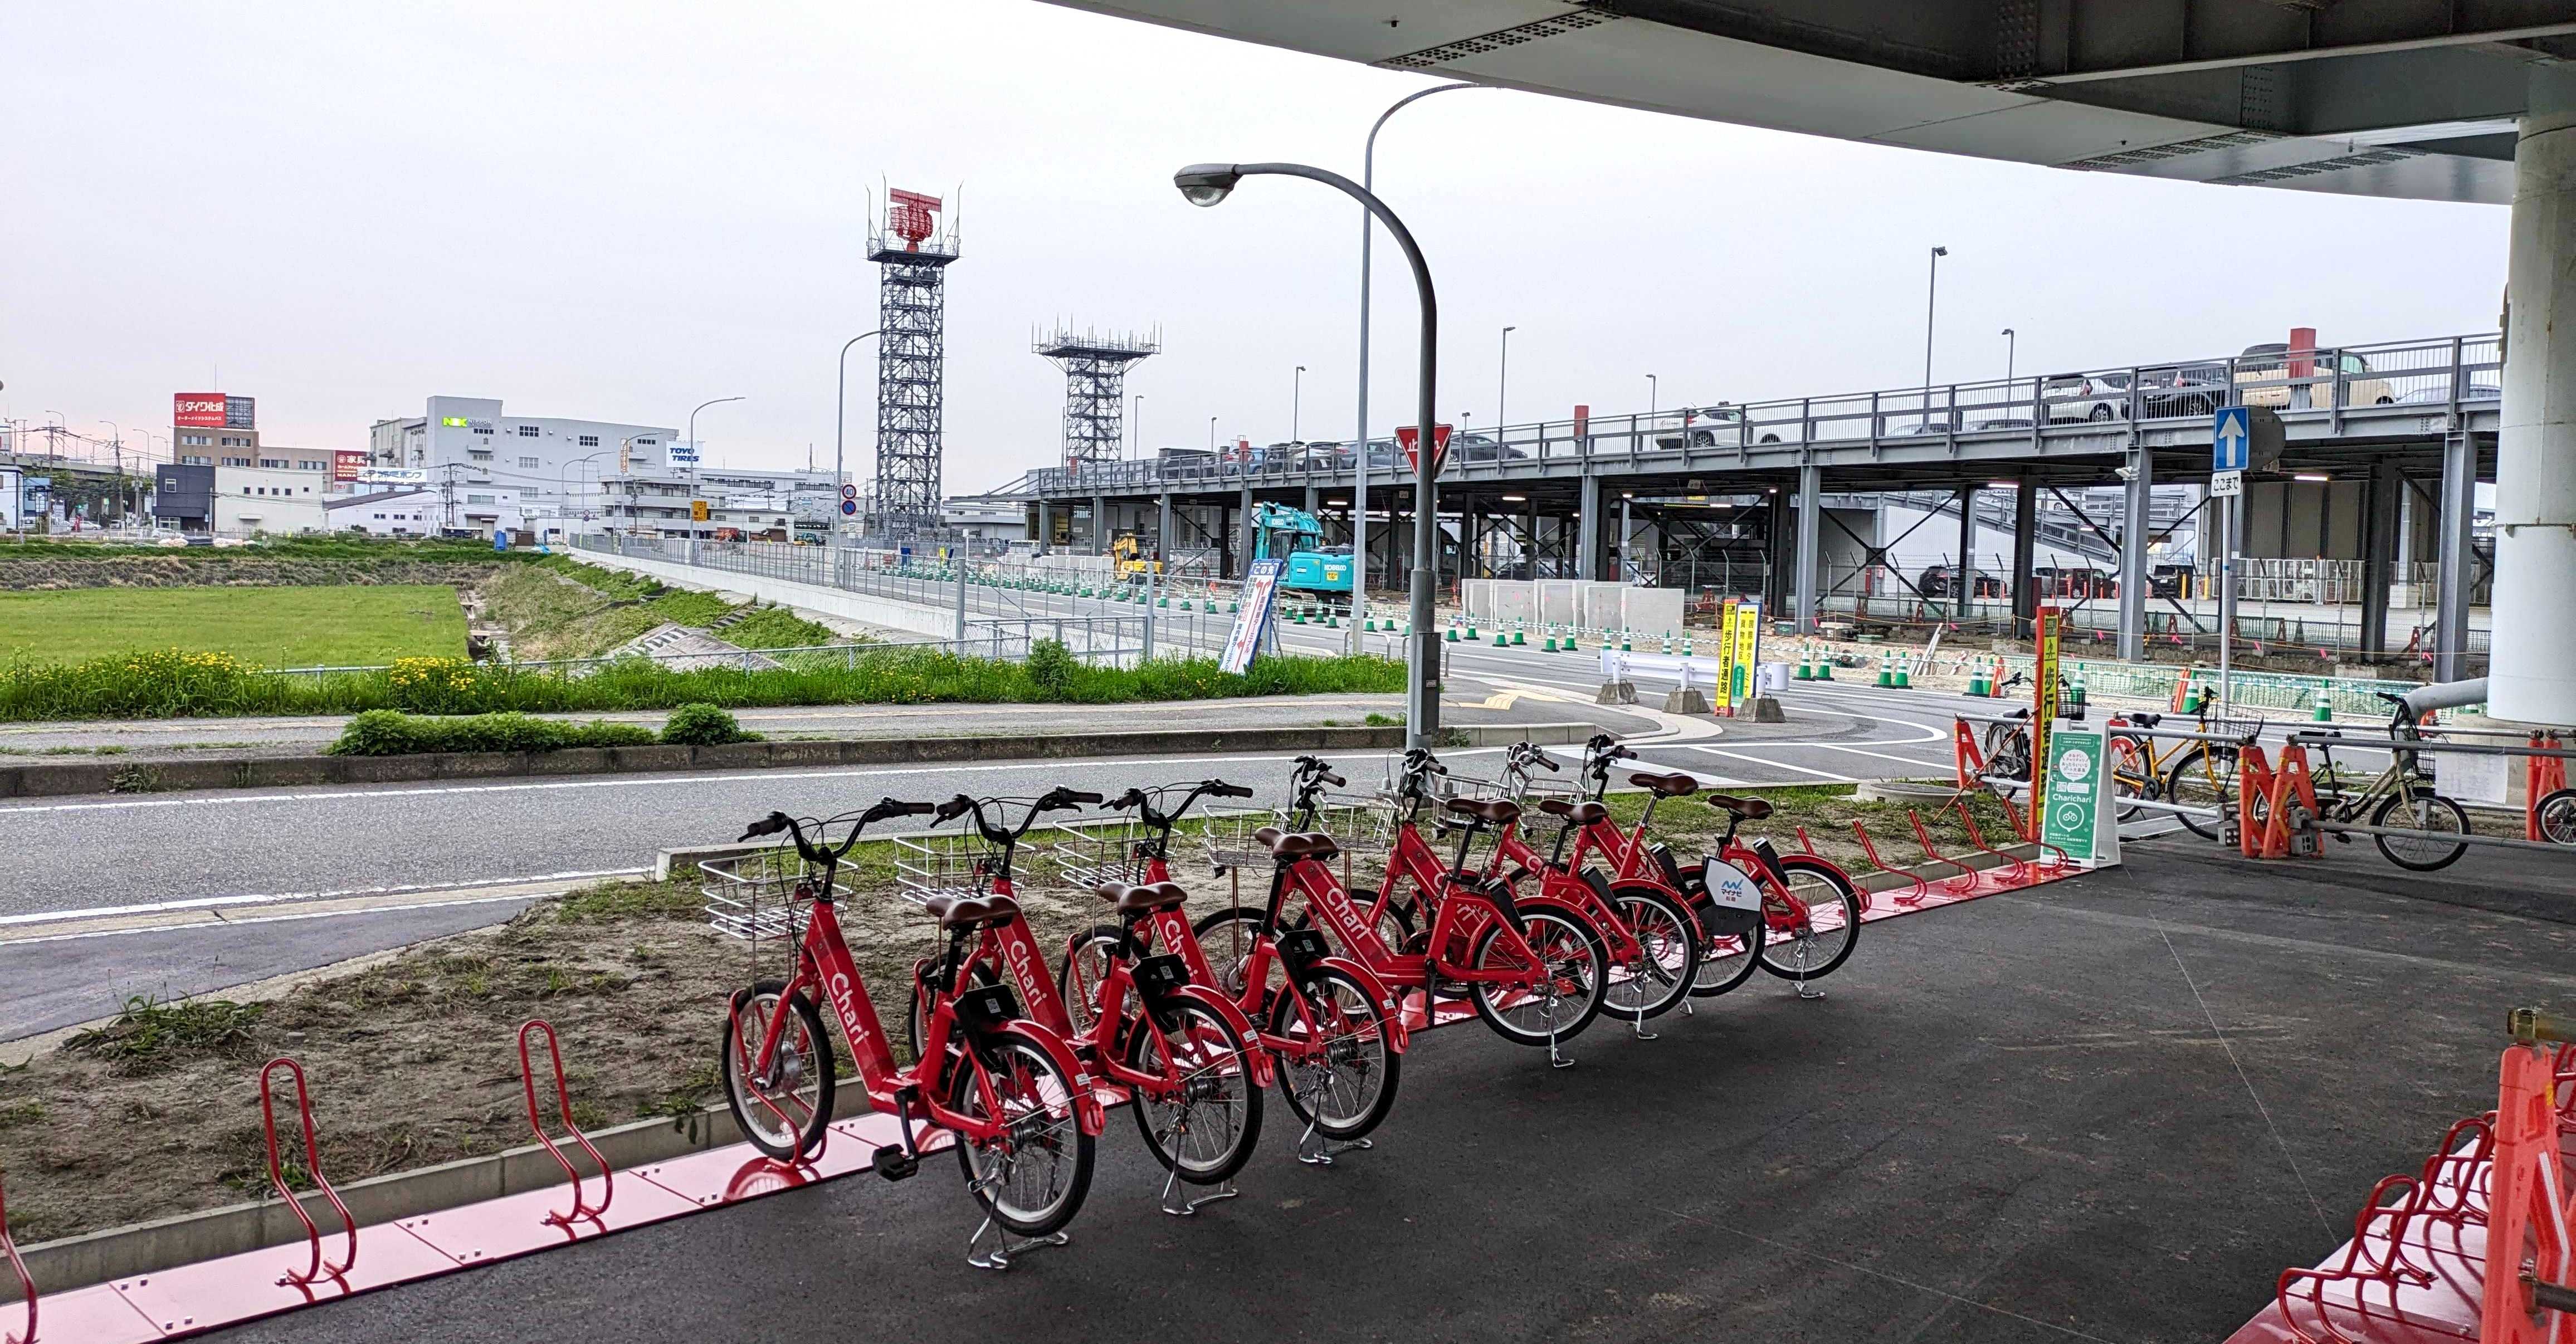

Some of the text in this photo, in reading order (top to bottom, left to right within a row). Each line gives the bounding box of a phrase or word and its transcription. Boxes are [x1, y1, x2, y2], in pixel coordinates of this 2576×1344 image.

[186, 402, 224, 412] ダイワ化成
[2214, 477, 2238, 491] ここまで
[1253, 566, 1275, 574] この先
[1720, 630, 1732, 693] 歩行者通路
[2052, 794, 2092, 803] Charichari
[1721, 888, 1742, 897] マイナビ
[1327, 888, 1370, 940] Chari
[1011, 940, 1047, 1007] Chari
[832, 972, 870, 1045] Chari
